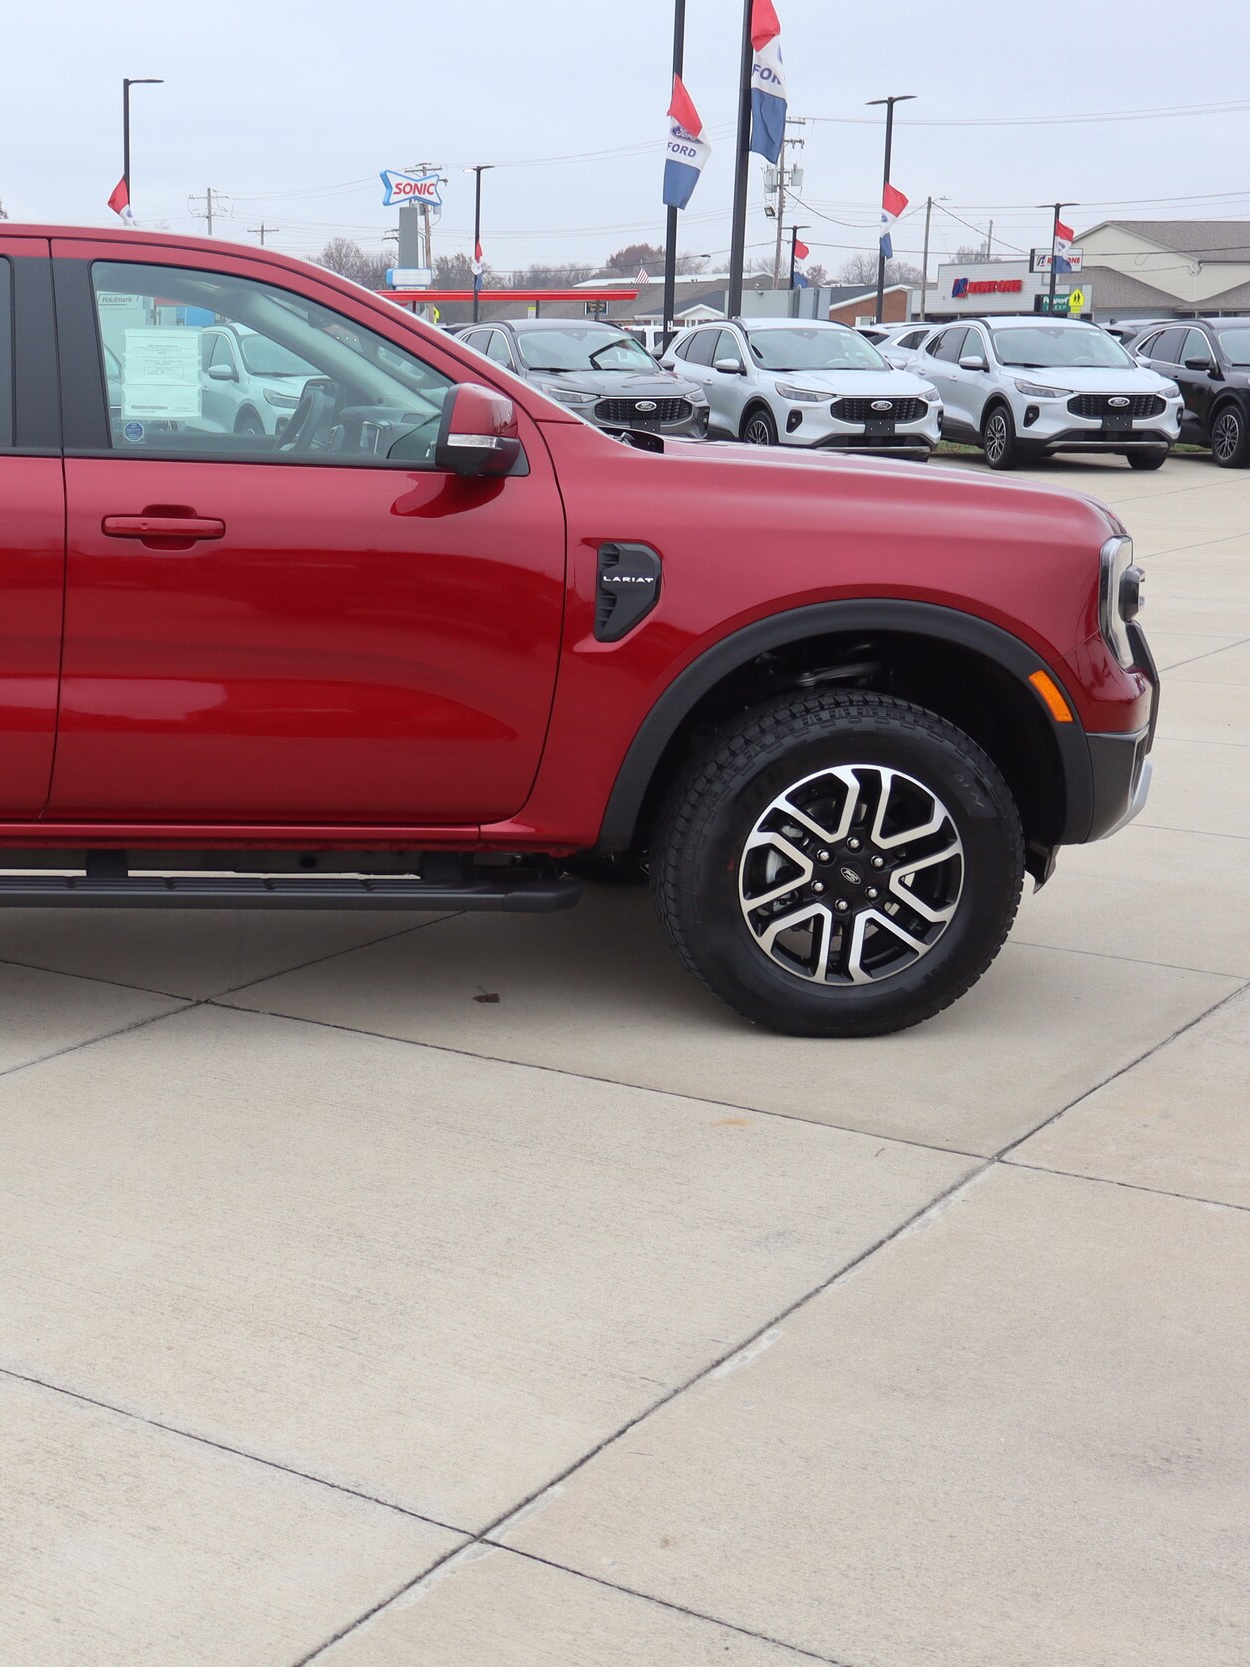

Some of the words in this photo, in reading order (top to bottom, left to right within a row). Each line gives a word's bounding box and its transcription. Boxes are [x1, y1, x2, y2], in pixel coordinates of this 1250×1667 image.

[667, 141, 697, 158] FORD
[393, 182, 436, 195] SONIC
[997, 279, 1023, 293] ONE
[603, 575, 654, 584] LARIAT
